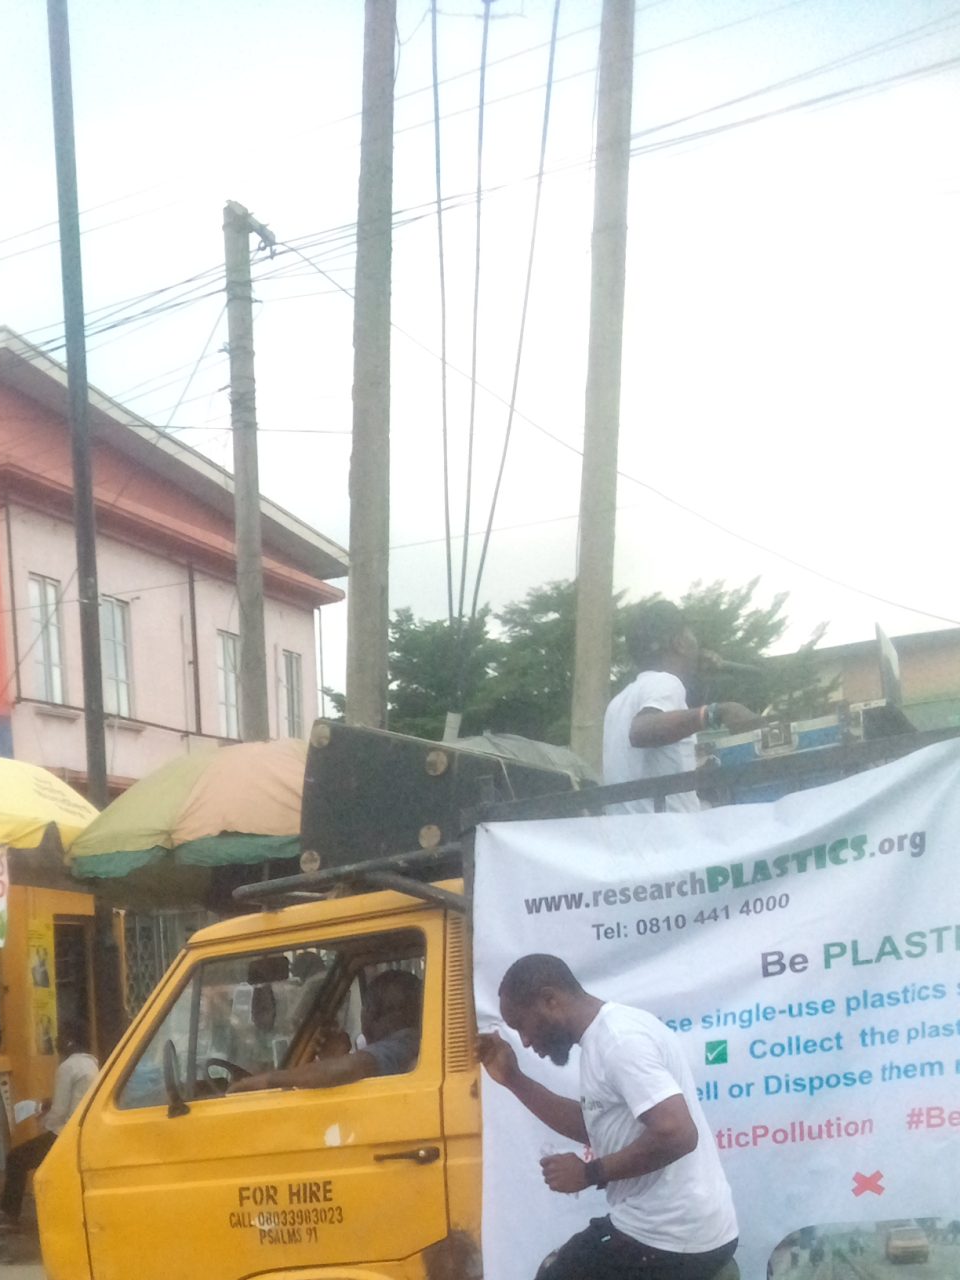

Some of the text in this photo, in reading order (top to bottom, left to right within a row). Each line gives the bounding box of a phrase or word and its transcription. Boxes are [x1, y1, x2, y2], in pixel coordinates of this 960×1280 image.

[524, 831, 927, 915] www.researchPLASTICS.org
[591, 893, 791, 941] Tel: 0810 441 4000
[760, 950, 809, 978] Be
[701, 998, 836, 1030] single-use
[845, 983, 947, 1017] plastics
[749, 1032, 844, 1060] Collect
[859, 1026, 900, 1048] the
[728, 1080, 755, 1099] or
[763, 1069, 873, 1096] Dispose
[880, 1060, 944, 1082] them
[238, 1180, 334, 1207] FOR HIRE
[229, 1212, 253, 1229] CALL
[260, 1226, 319, 1245] PSALMS 91
